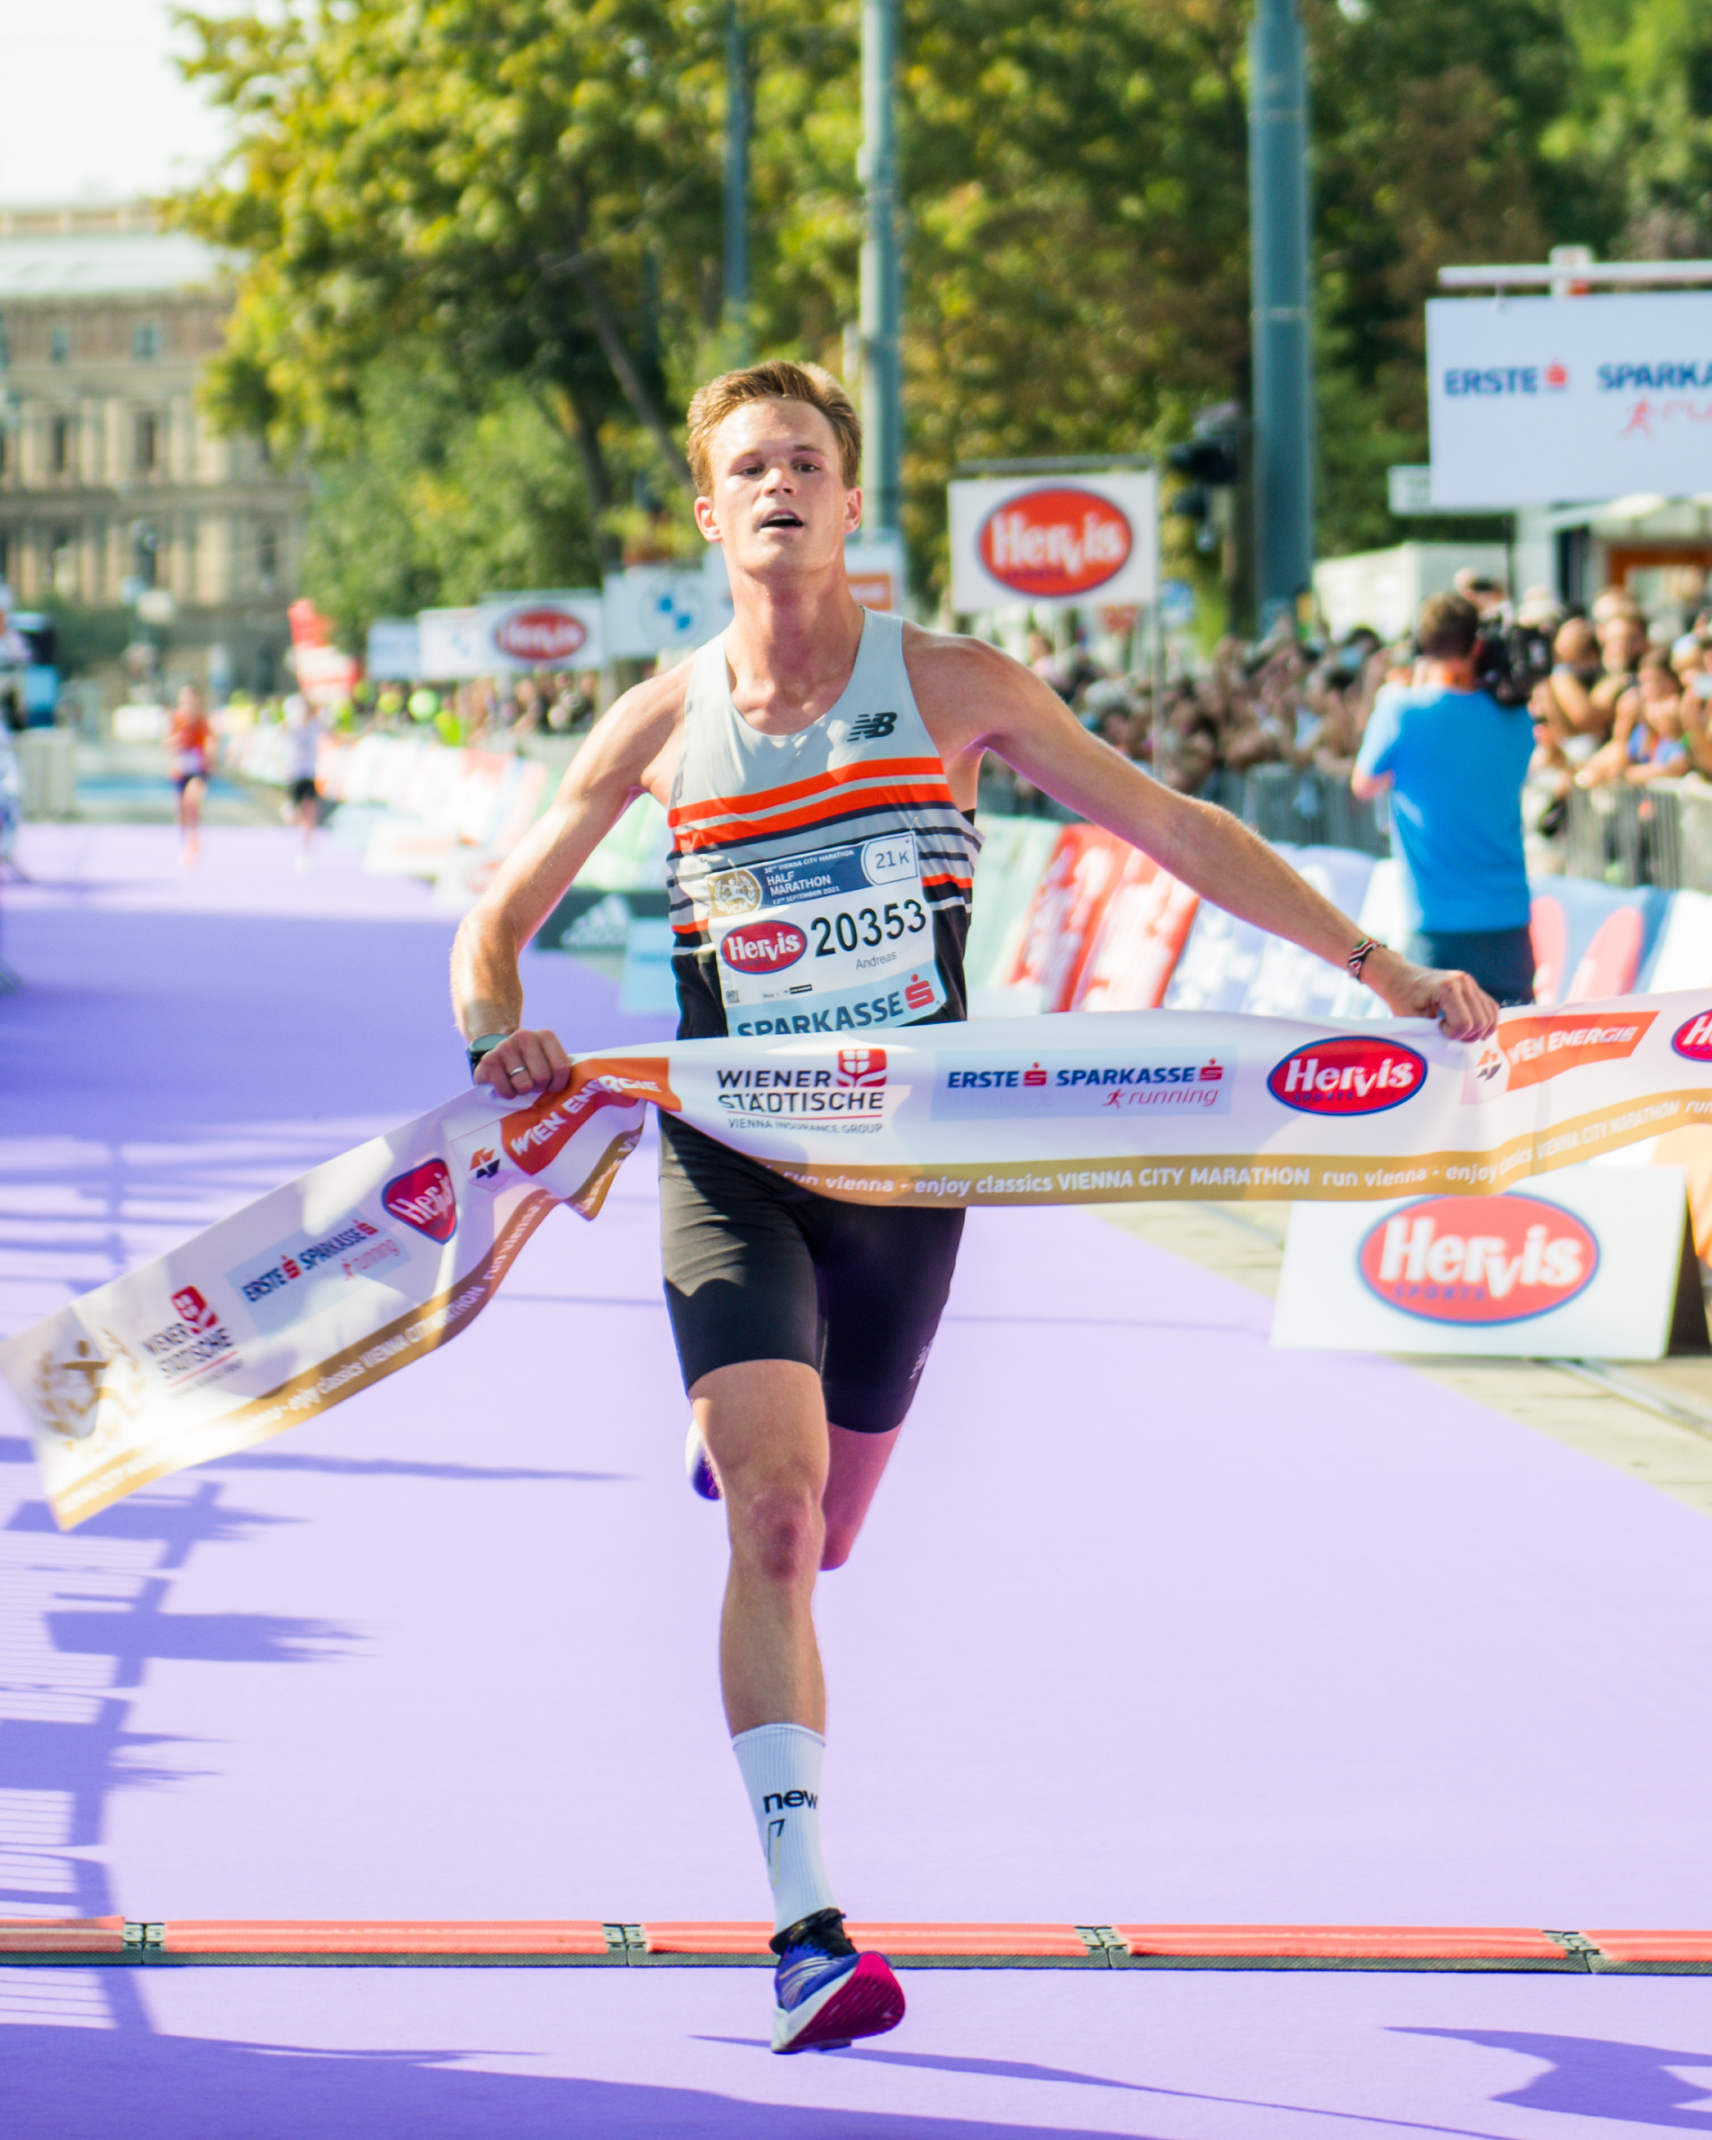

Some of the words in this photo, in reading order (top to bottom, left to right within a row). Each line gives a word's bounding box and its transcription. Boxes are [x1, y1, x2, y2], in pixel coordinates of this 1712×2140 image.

[1444, 365, 1539, 396] ERSTE
[990, 511, 1124, 577] Hervis
[778, 860, 803, 872] VIENNA
[803, 857, 818, 866] CITY
[818, 849, 855, 863] MARATHON
[875, 850, 896, 869] 21
[898, 850, 910, 865] K
[766, 870, 795, 887] HALF
[769, 874, 832, 897] MARATHON
[785, 889, 822, 903] SEPTEMBER
[823, 885, 840, 896] 2021
[810, 898, 927, 958] 20353
[726, 931, 801, 962] Hervis
[855, 951, 898, 971] Andreas
[737, 991, 904, 1036] SPARKASSE
[1547, 1026, 1639, 1053] ENERGIE
[717, 1070, 831, 1088] WIENER
[947, 1070, 1020, 1089] ERSTE
[1055, 1067, 1196, 1087] SPARKASSE
[1284, 1057, 1414, 1098] Hervis
[717, 1091, 884, 1113] STÄDTISCHE
[1128, 1087, 1220, 1107] running
[510, 1111, 567, 1156] WIEN
[728, 1118, 772, 1129] VIENNA
[774, 1121, 839, 1133] INSURANCE
[842, 1123, 883, 1134] GROUP
[825, 1174, 895, 1193] vienna
[914, 1176, 972, 1198] enjoy
[976, 1173, 1053, 1194] classics
[1057, 1170, 1135, 1191] VIENNA
[1138, 1167, 1186, 1186] CITY
[1189, 1166, 1311, 1186] MARATHON
[1321, 1169, 1359, 1187] run
[1364, 1167, 1428, 1187] vienna
[1446, 1162, 1498, 1185] enjoy
[1536, 1131, 1581, 1160] VIENNA
[1581, 1121, 1608, 1146] CITY
[1609, 1098, 1682, 1136] MARATHON
[482, 1254, 508, 1281] run
[502, 1205, 542, 1251] vienna
[242, 1267, 289, 1302] ERSTE
[298, 1227, 368, 1271] SPARKASSE
[1378, 1216, 1583, 1299] Hervis
[1393, 1284, 1488, 1302] SPORTS
[763, 1789, 818, 1814] new
